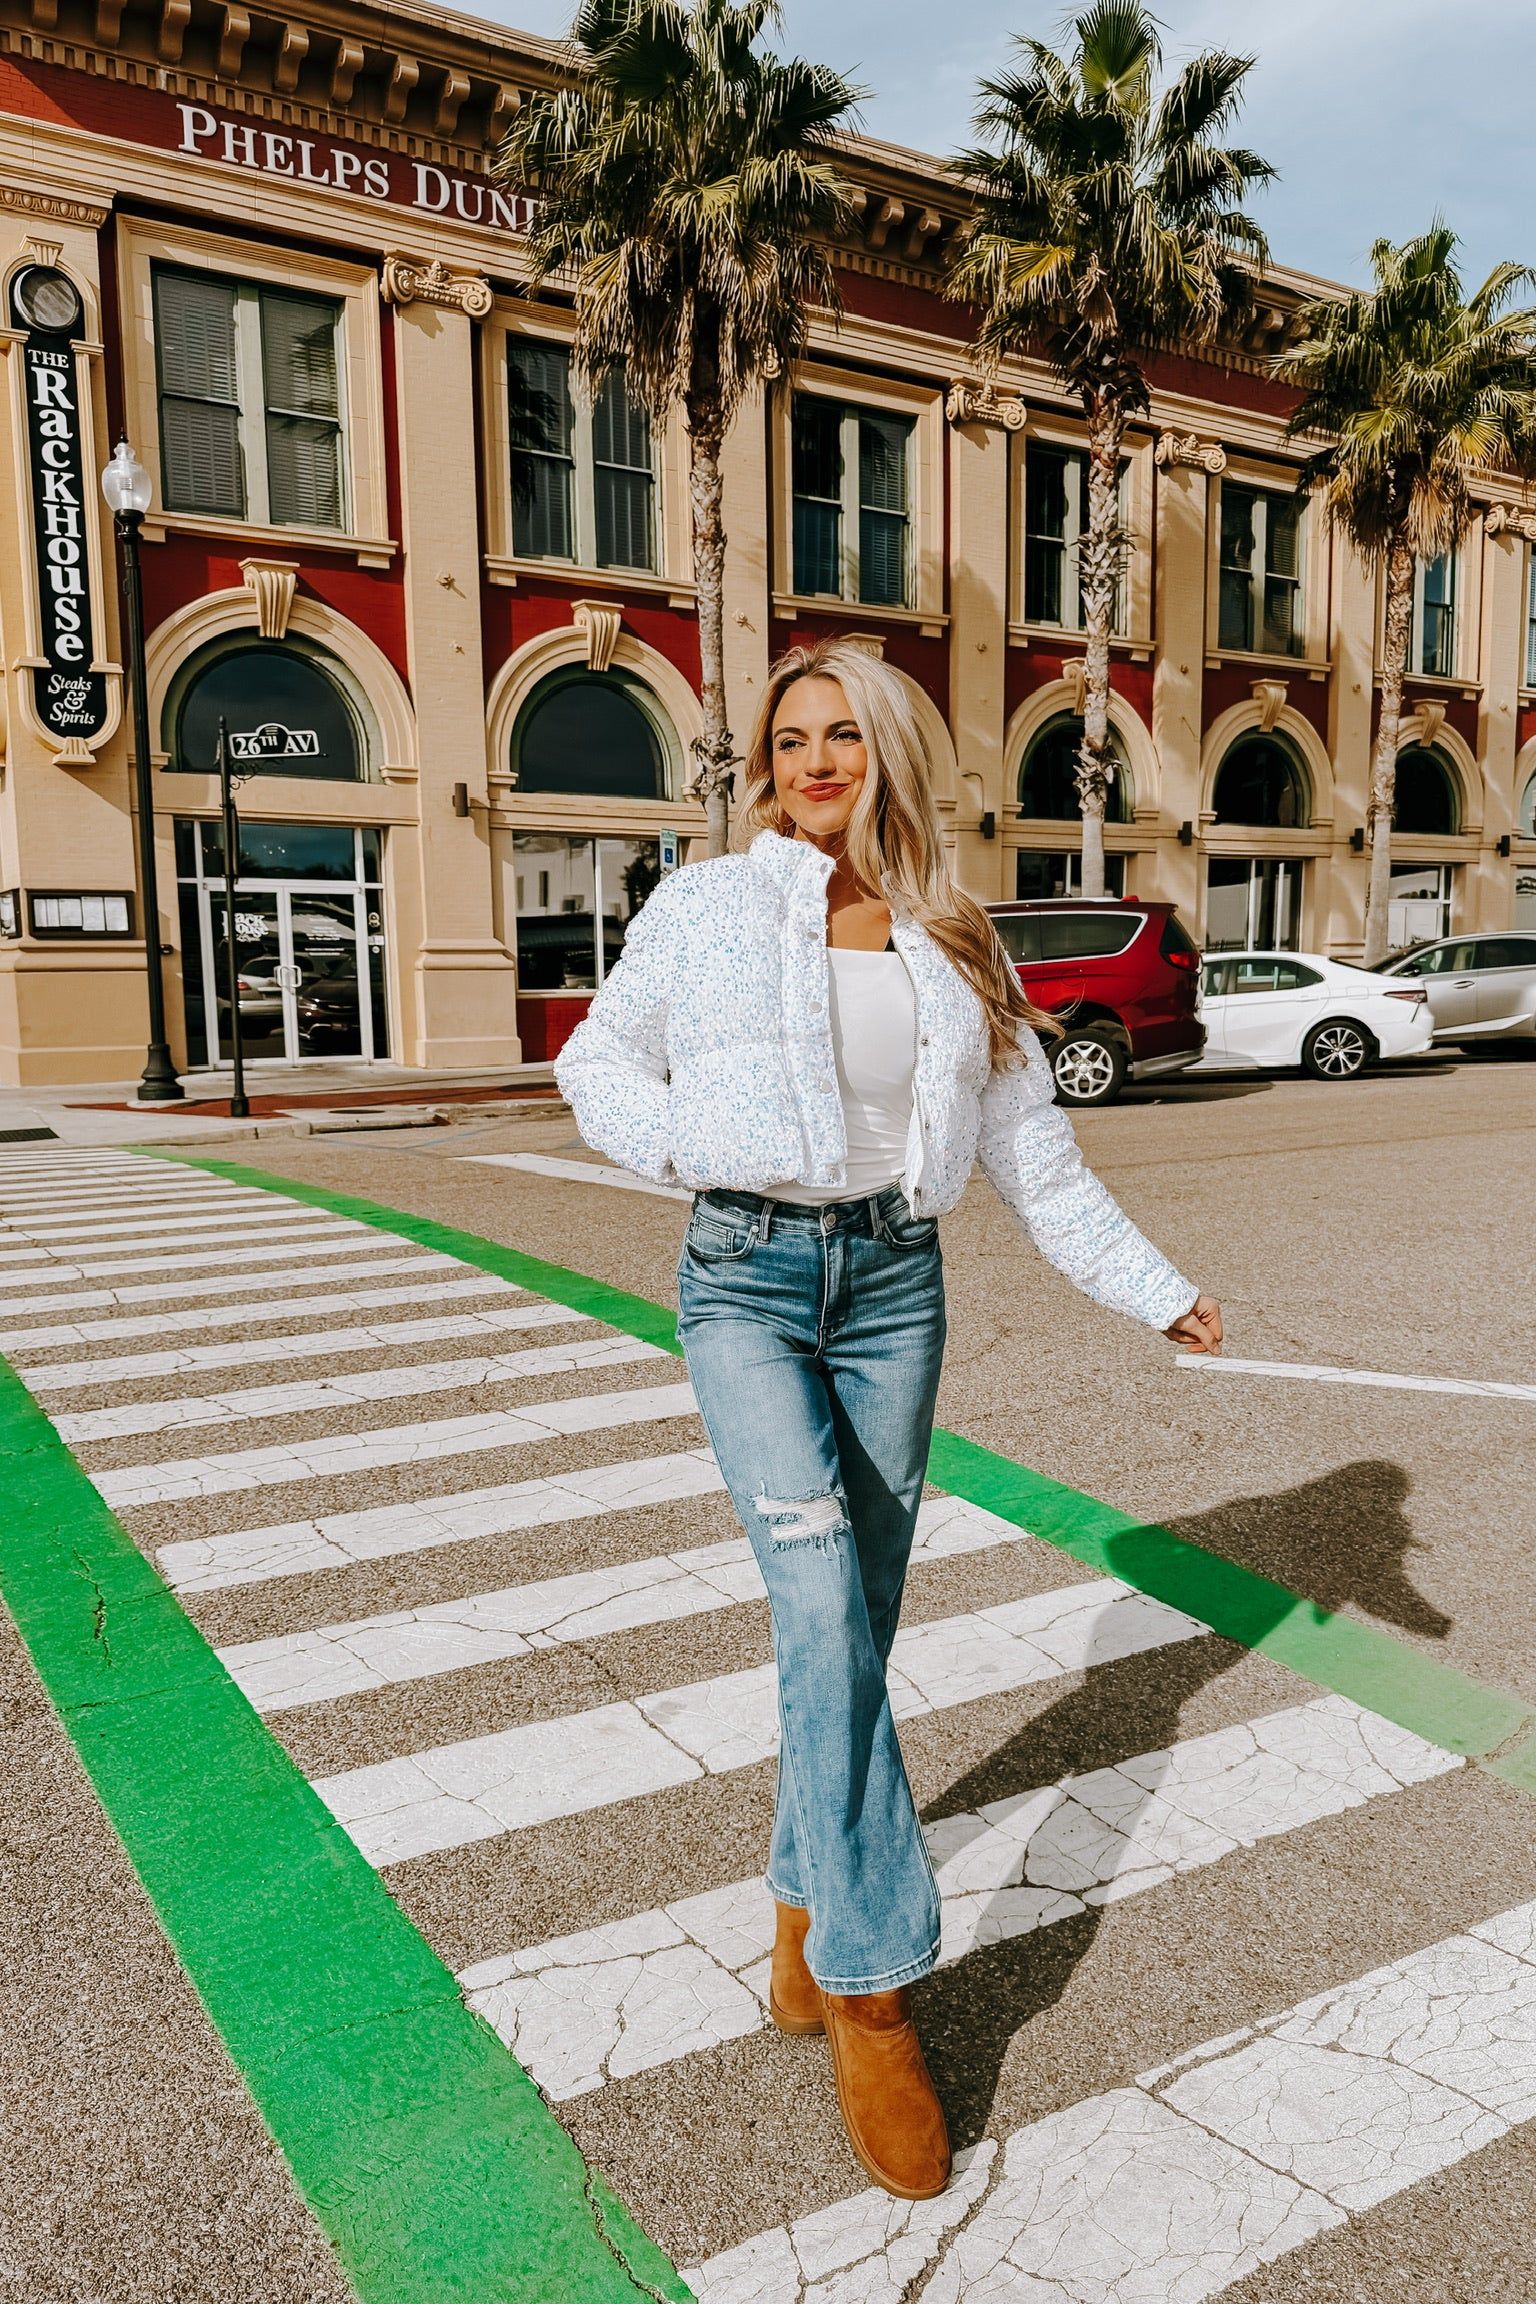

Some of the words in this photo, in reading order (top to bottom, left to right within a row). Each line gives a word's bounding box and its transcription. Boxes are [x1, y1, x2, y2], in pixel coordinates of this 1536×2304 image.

[175, 103, 390, 199] PHELPS
[27, 349, 70, 369] THE
[47, 673, 93, 708] Steaks
[63, 689, 87, 712] &
[49, 702, 96, 727] Spirits
[235, 735, 278, 756] 26TH
[283, 734, 312, 754] AV
